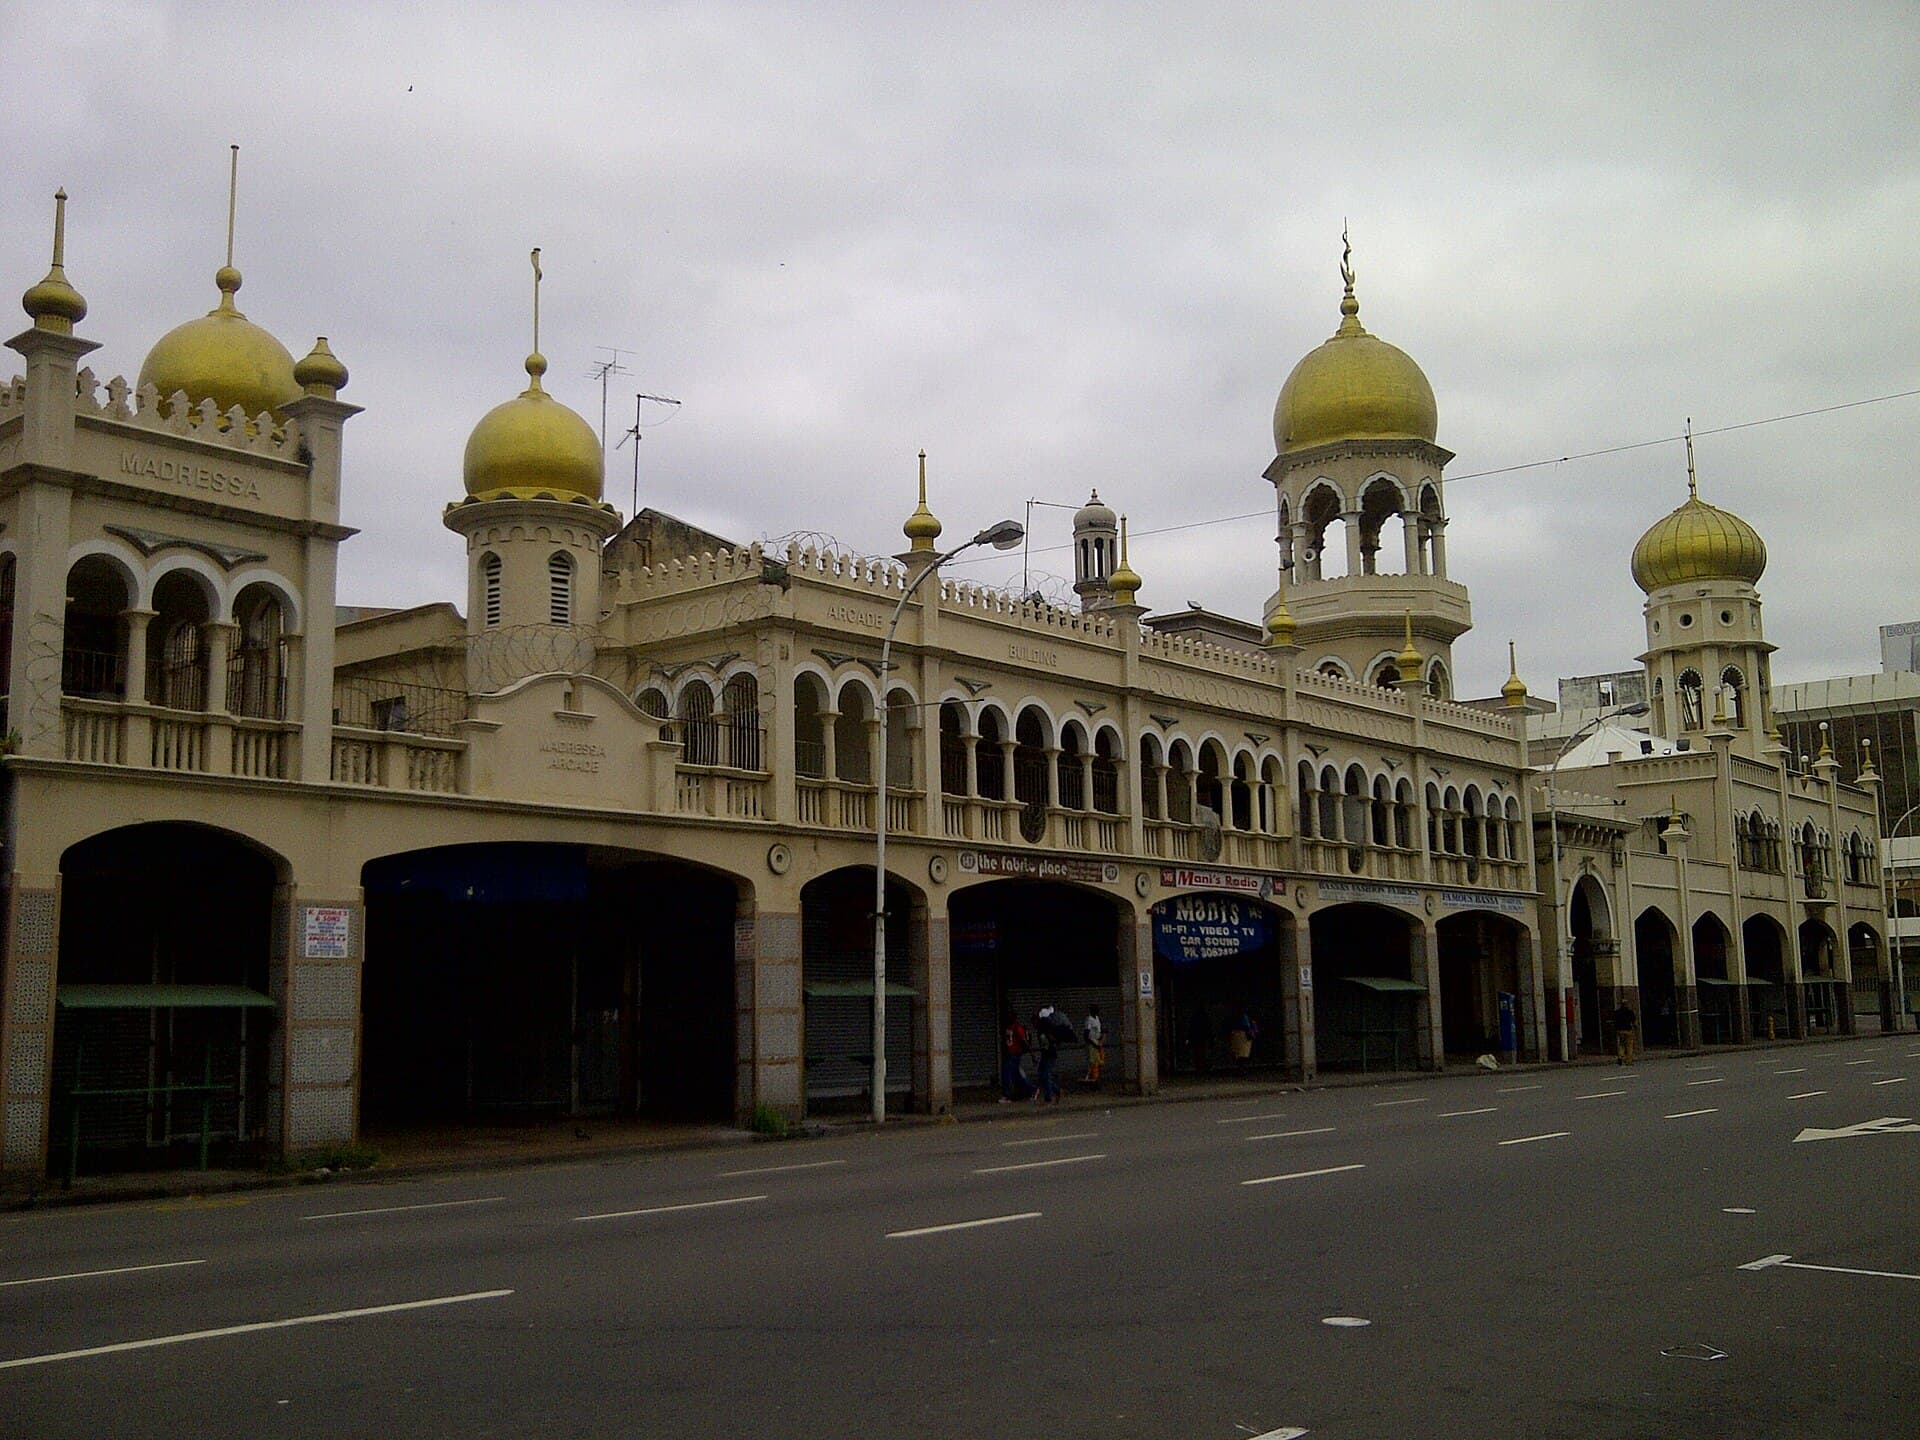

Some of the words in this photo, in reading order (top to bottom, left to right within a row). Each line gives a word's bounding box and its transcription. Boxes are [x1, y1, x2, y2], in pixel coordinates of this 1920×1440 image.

[120, 450, 261, 501] MADRESSA
[827, 605, 883, 629] ARCADE
[1008, 643, 1057, 667] BUILDING
[540, 739, 606, 758] MADRESSA
[548, 757, 599, 773] ARCADE
[978, 854, 998, 870] the
[1001, 855, 1036, 873] fabric
[1039, 859, 1068, 878] place
[1178, 870, 1221, 886] Mani's
[1225, 875, 1258, 888] Radio
[1442, 892, 1473, 903] FAMOUS
[1176, 896, 1240, 926] Mani's
[1161, 924, 1188, 934] HI-FI
[1199, 926, 1230, 936] VIDEO
[1241, 927, 1255, 936] TV
[1180, 936, 1201, 946] CAR
[1205, 937, 1240, 947] SOUND
